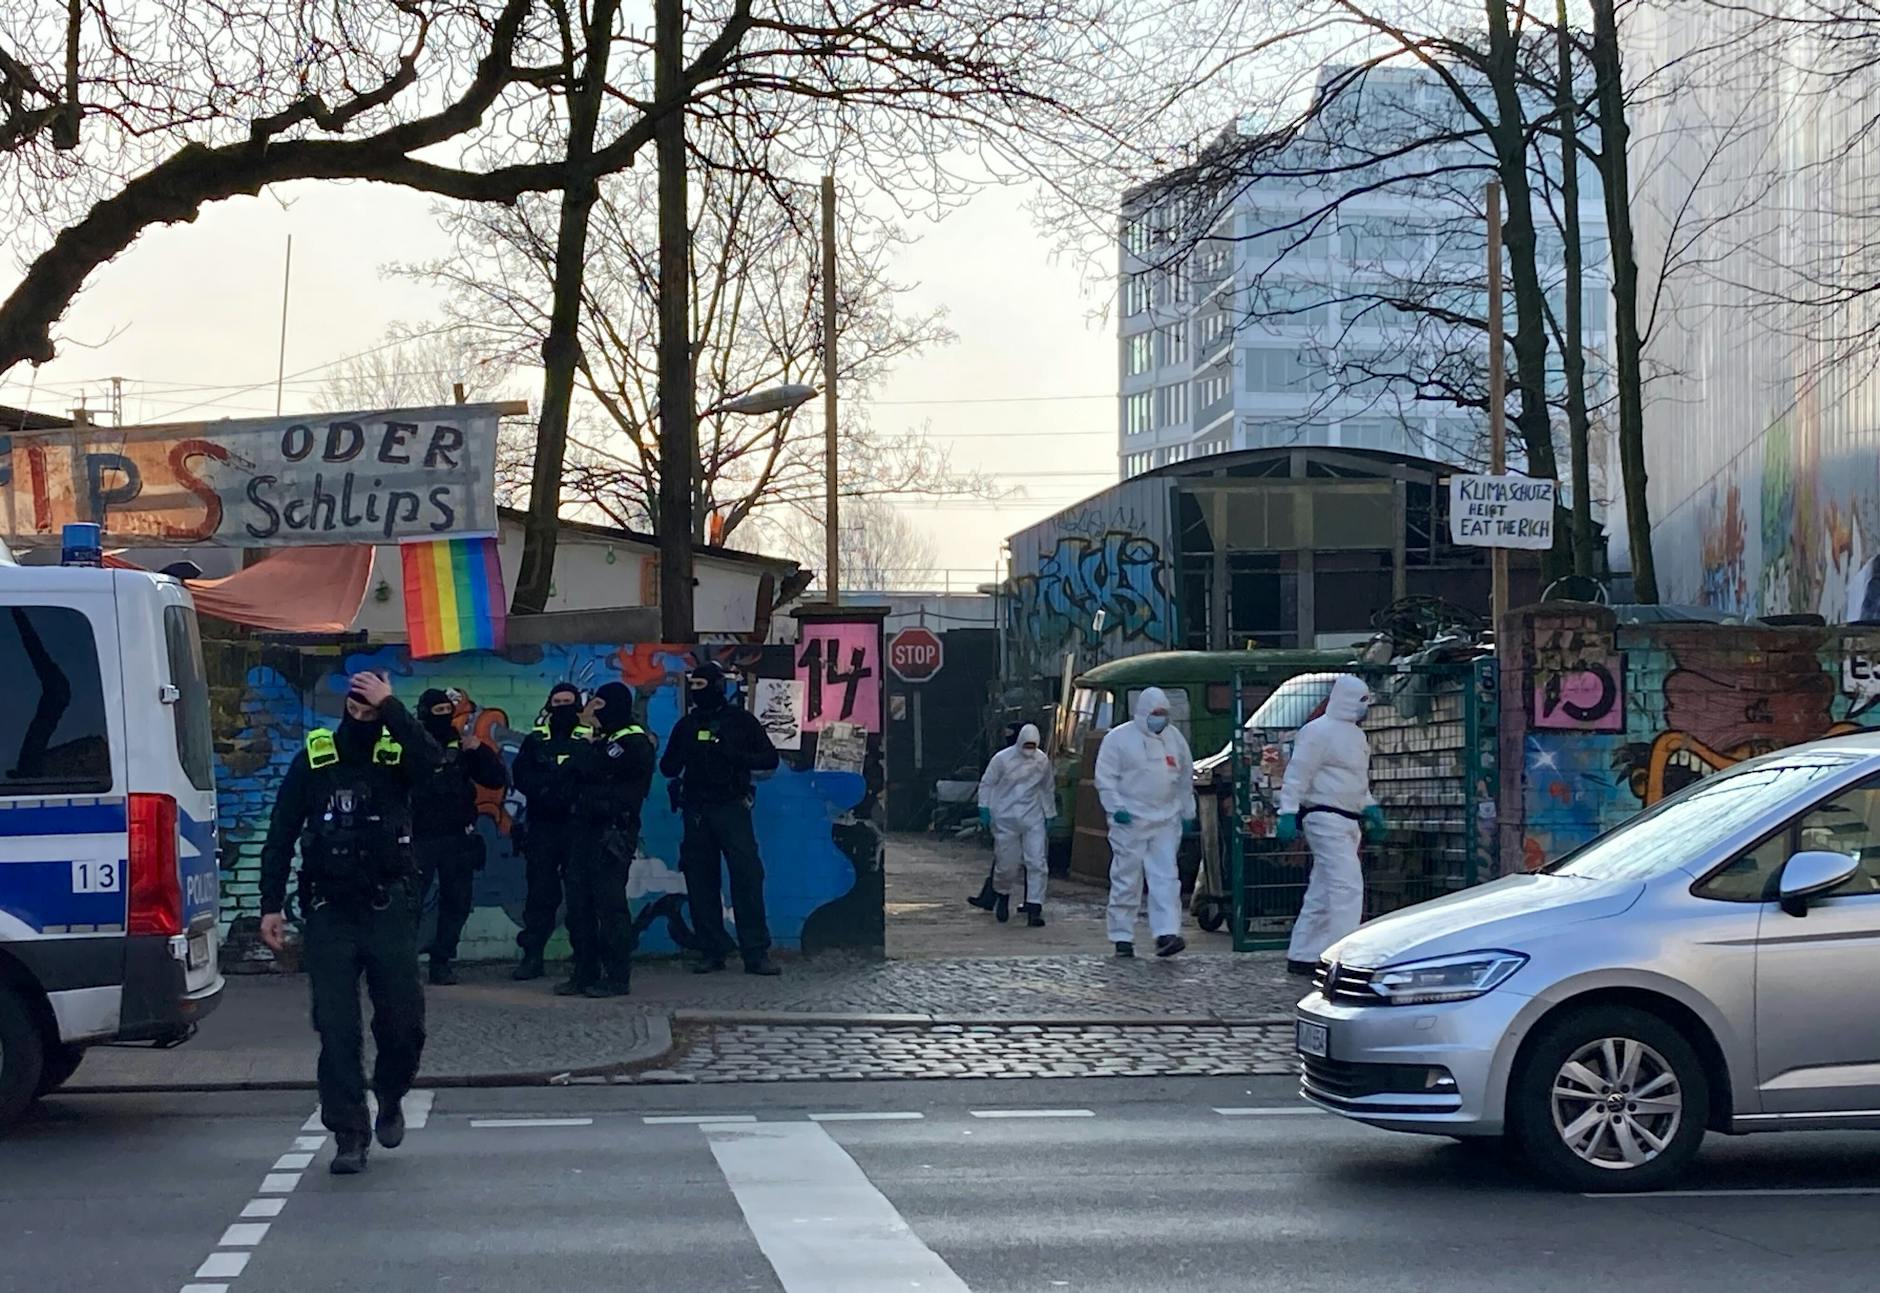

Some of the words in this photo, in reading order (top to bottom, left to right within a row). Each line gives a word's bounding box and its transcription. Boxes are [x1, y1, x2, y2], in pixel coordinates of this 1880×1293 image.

[281, 420, 464, 468] ODER
[246, 472, 455, 539] Schlips
[1460, 479, 1552, 501] KLIMASCHUTZ
[1460, 519, 1492, 536] EAT
[1496, 520, 1516, 536] THE
[1518, 518, 1549, 537] RICH
[895, 645, 935, 665] STOP
[798, 638, 872, 722] 14
